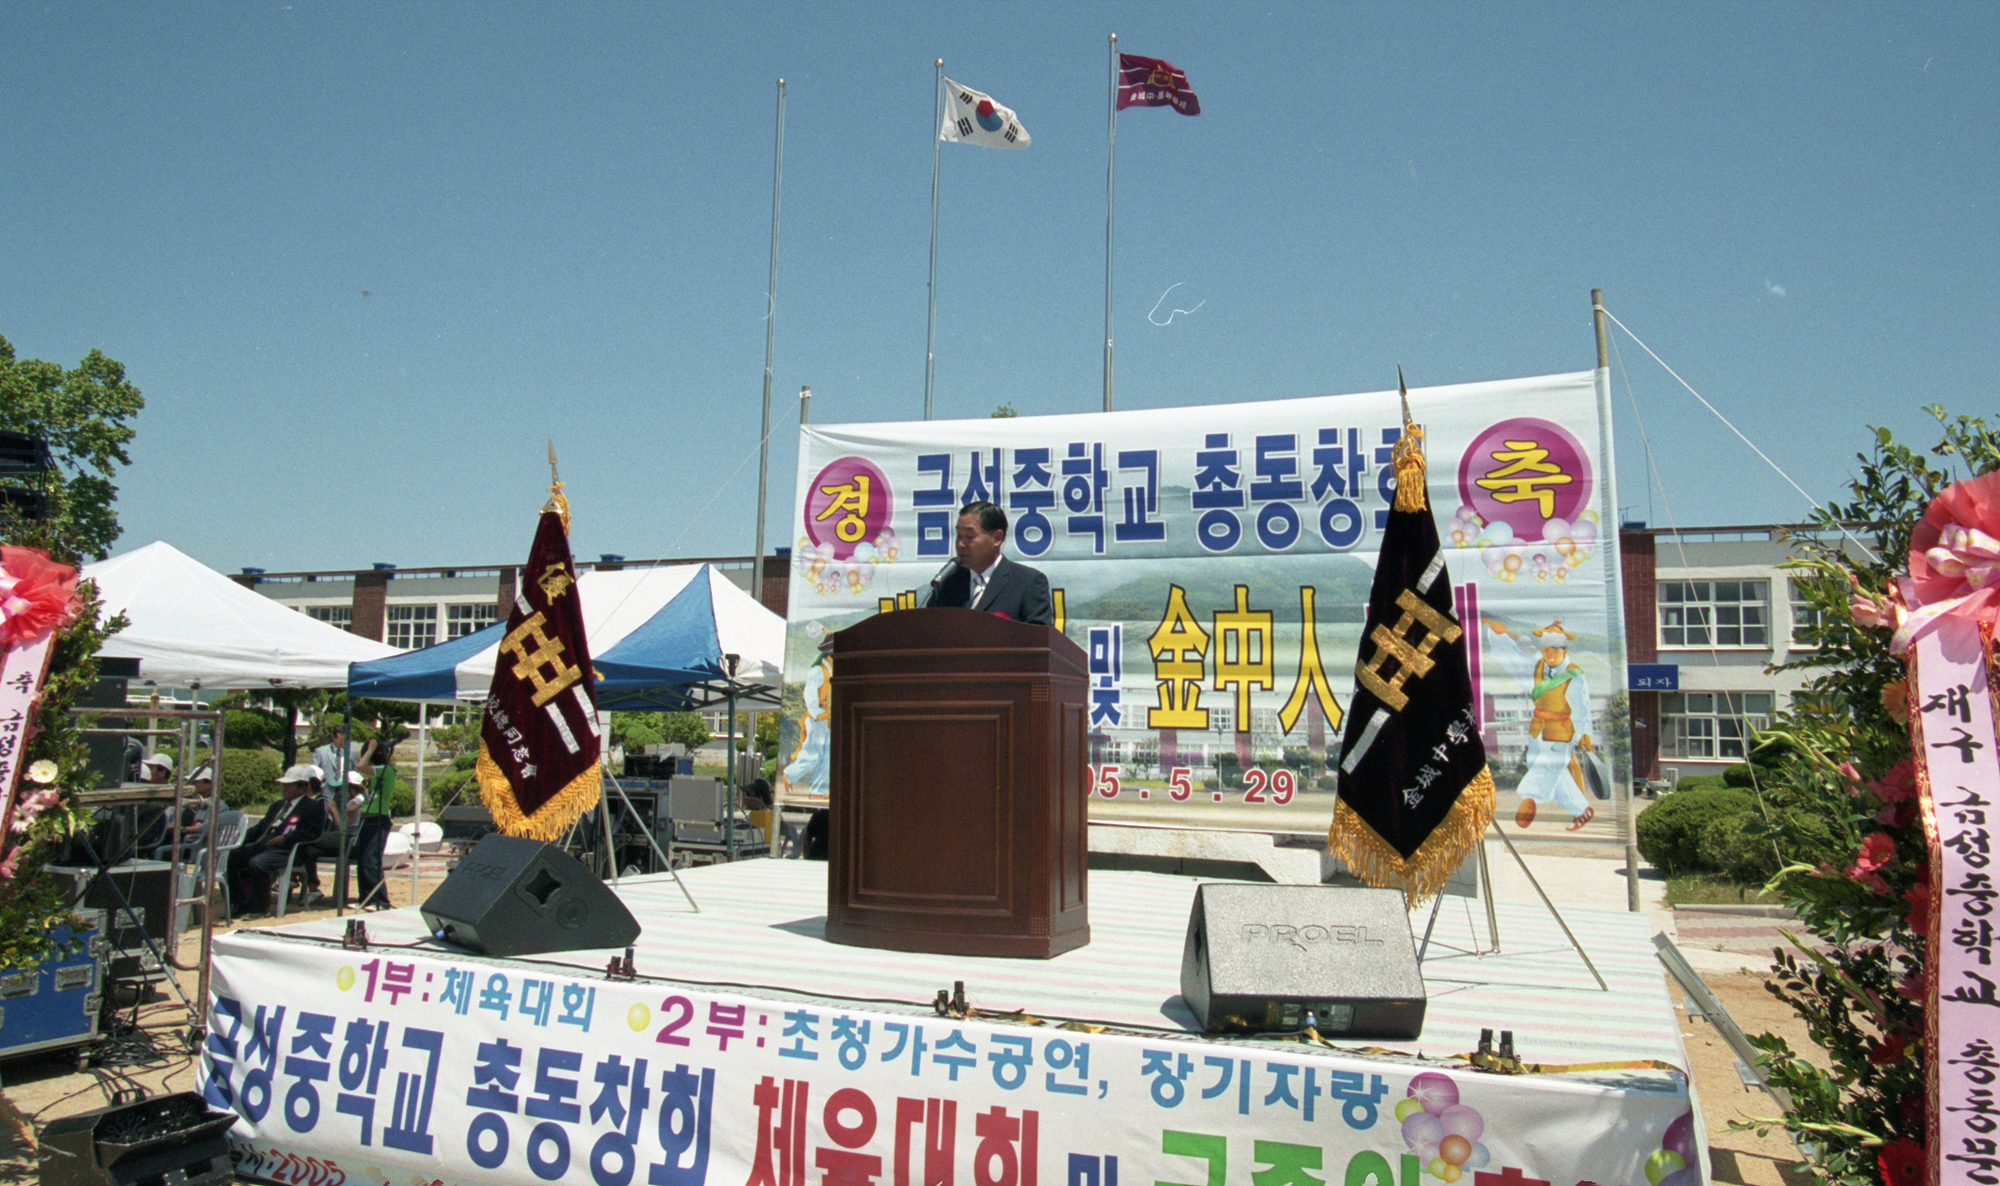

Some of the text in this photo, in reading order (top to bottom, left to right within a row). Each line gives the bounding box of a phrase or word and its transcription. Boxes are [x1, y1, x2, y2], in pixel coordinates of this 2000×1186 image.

[815, 474, 871, 543] 경
[1474, 439, 1573, 519] 축
[1147, 583, 1345, 736] 金中人
[1241, 924, 1384, 949] PROEL
[1939, 785, 2000, 1008] 금성중학교
[437, 966, 596, 1034] 체육대회
[201, 994, 444, 1156] 금성중학교
[465, 1037, 716, 1186] 총동창회
[777, 1008, 1110, 1100] 초청가수공연,
[1140, 1043, 1390, 1132] 장기자랑
